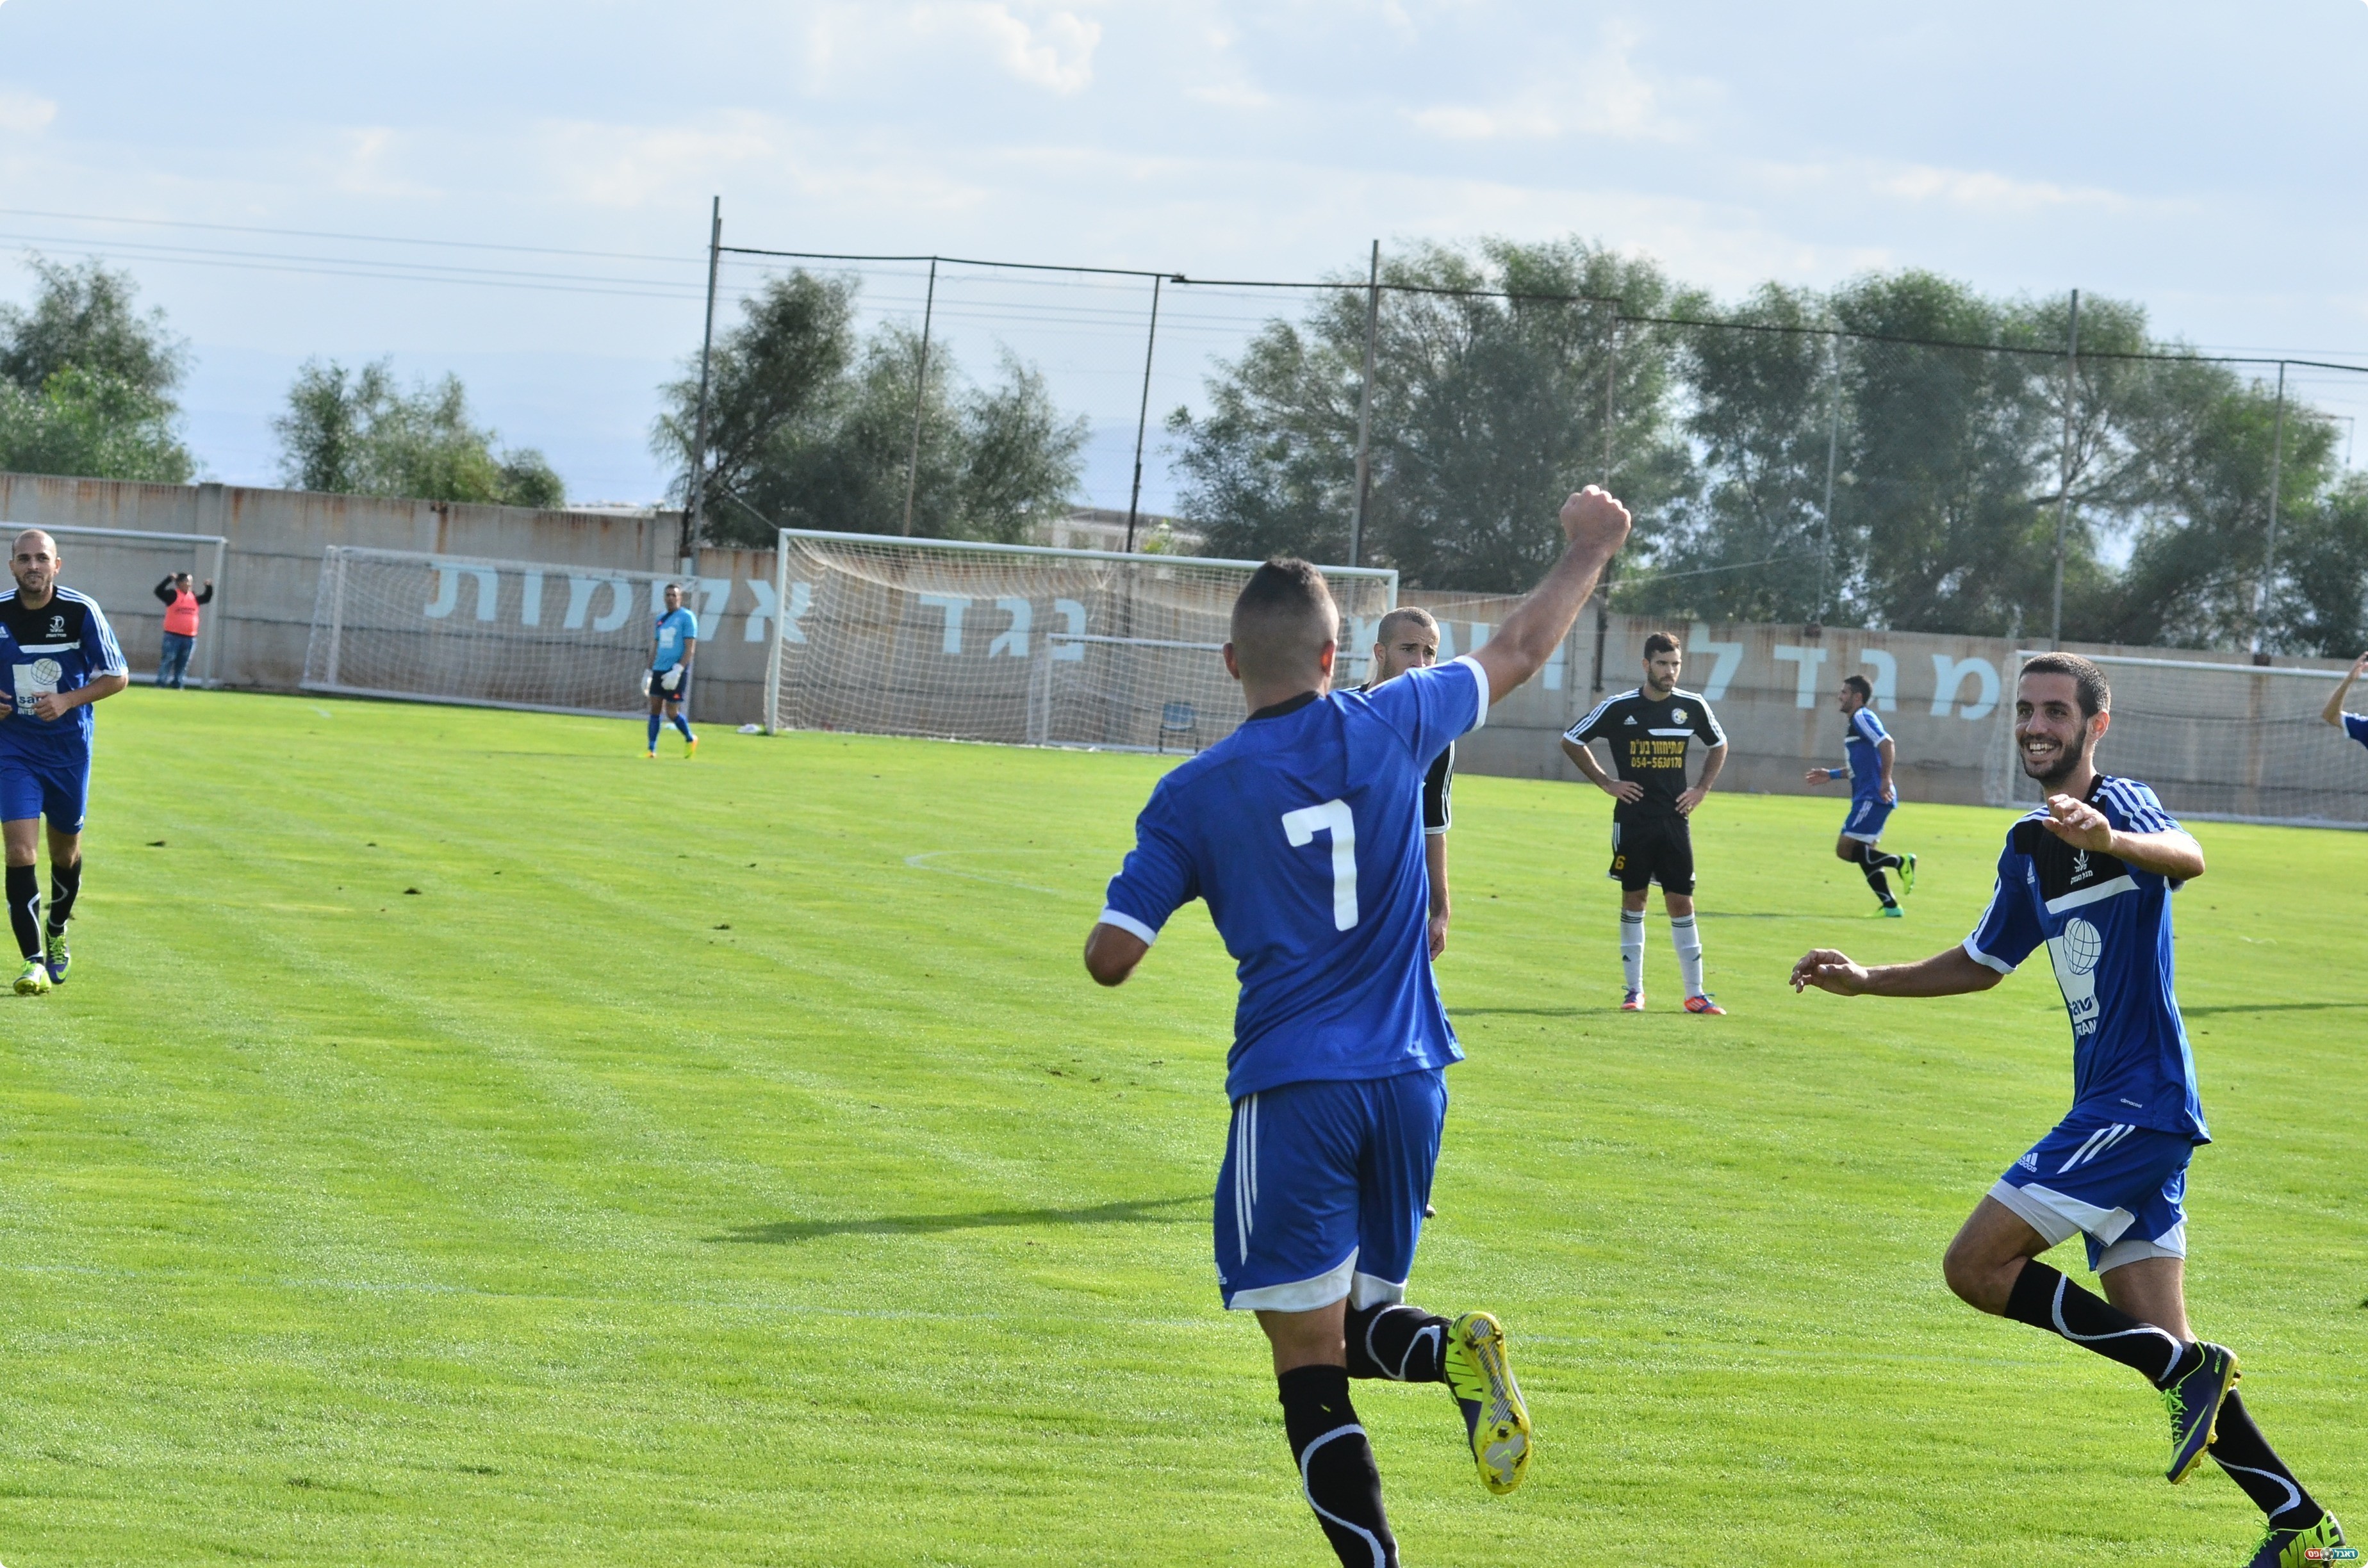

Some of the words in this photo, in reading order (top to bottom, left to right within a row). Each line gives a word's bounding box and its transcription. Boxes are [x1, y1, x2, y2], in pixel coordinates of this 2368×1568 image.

[919, 593, 1087, 660] נגד
[1688, 623, 2000, 720] מגדל
[1282, 799, 1359, 931] 7
[1615, 855, 1627, 870] 6
[2120, 1098, 2143, 1109] climacool
